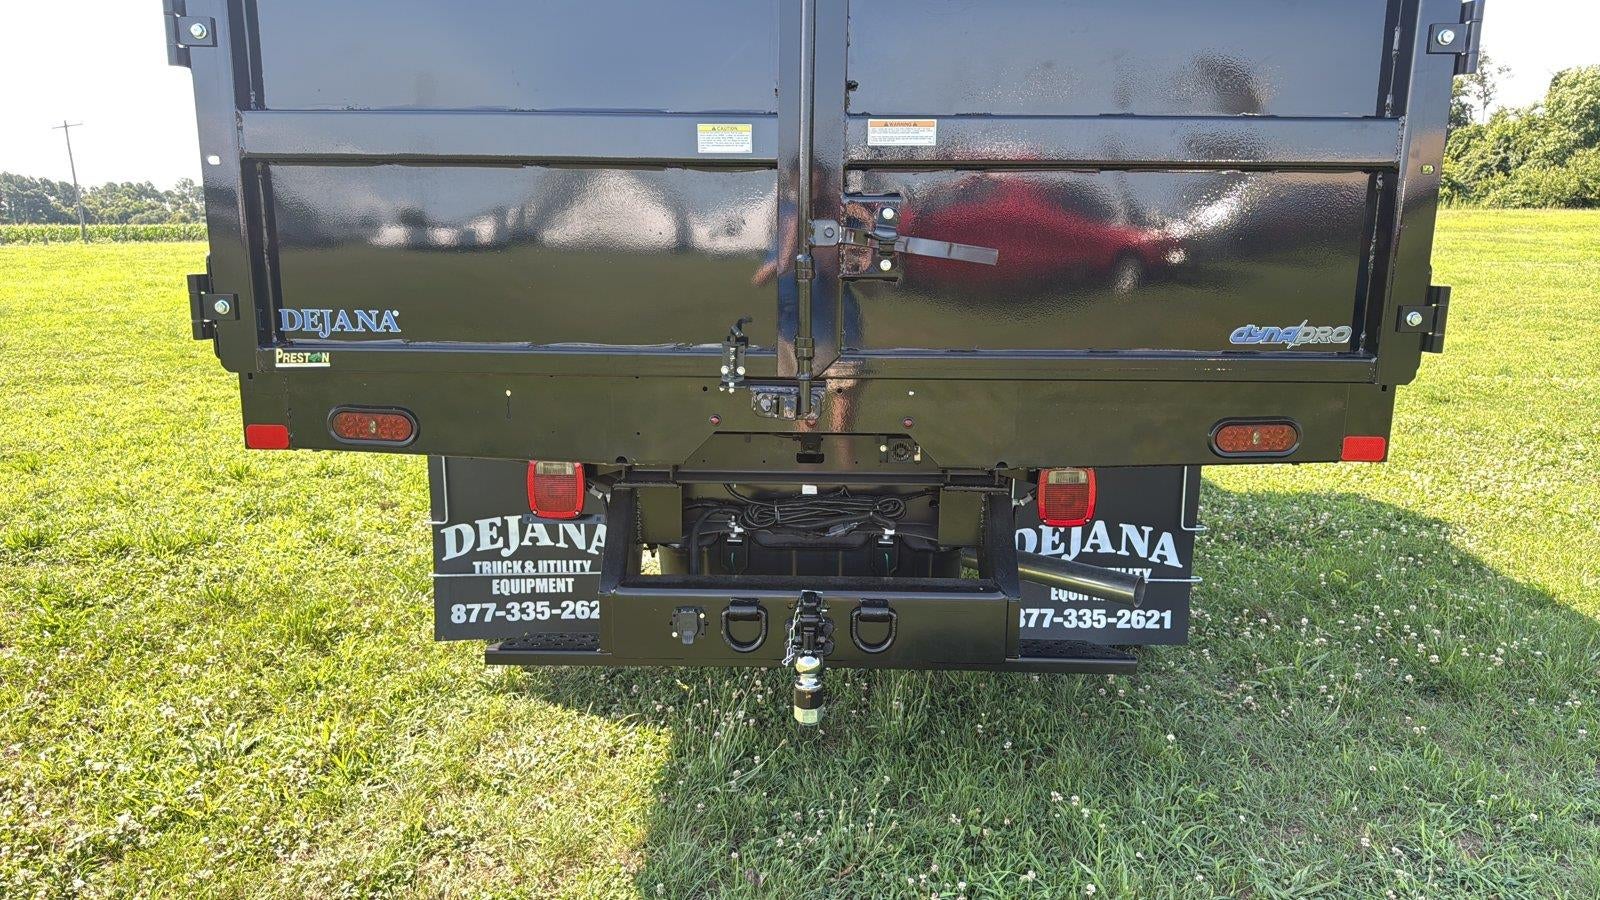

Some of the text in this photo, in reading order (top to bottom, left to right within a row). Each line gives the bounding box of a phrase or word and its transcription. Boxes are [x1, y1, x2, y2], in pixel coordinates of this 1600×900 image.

[278, 308, 401, 338] DEJANA
[275, 348, 330, 363] PRESTN
[440, 515, 607, 561] DEJANA
[492, 577, 575, 596] EQUIPMENT
[451, 600, 600, 624] 877-335-262
